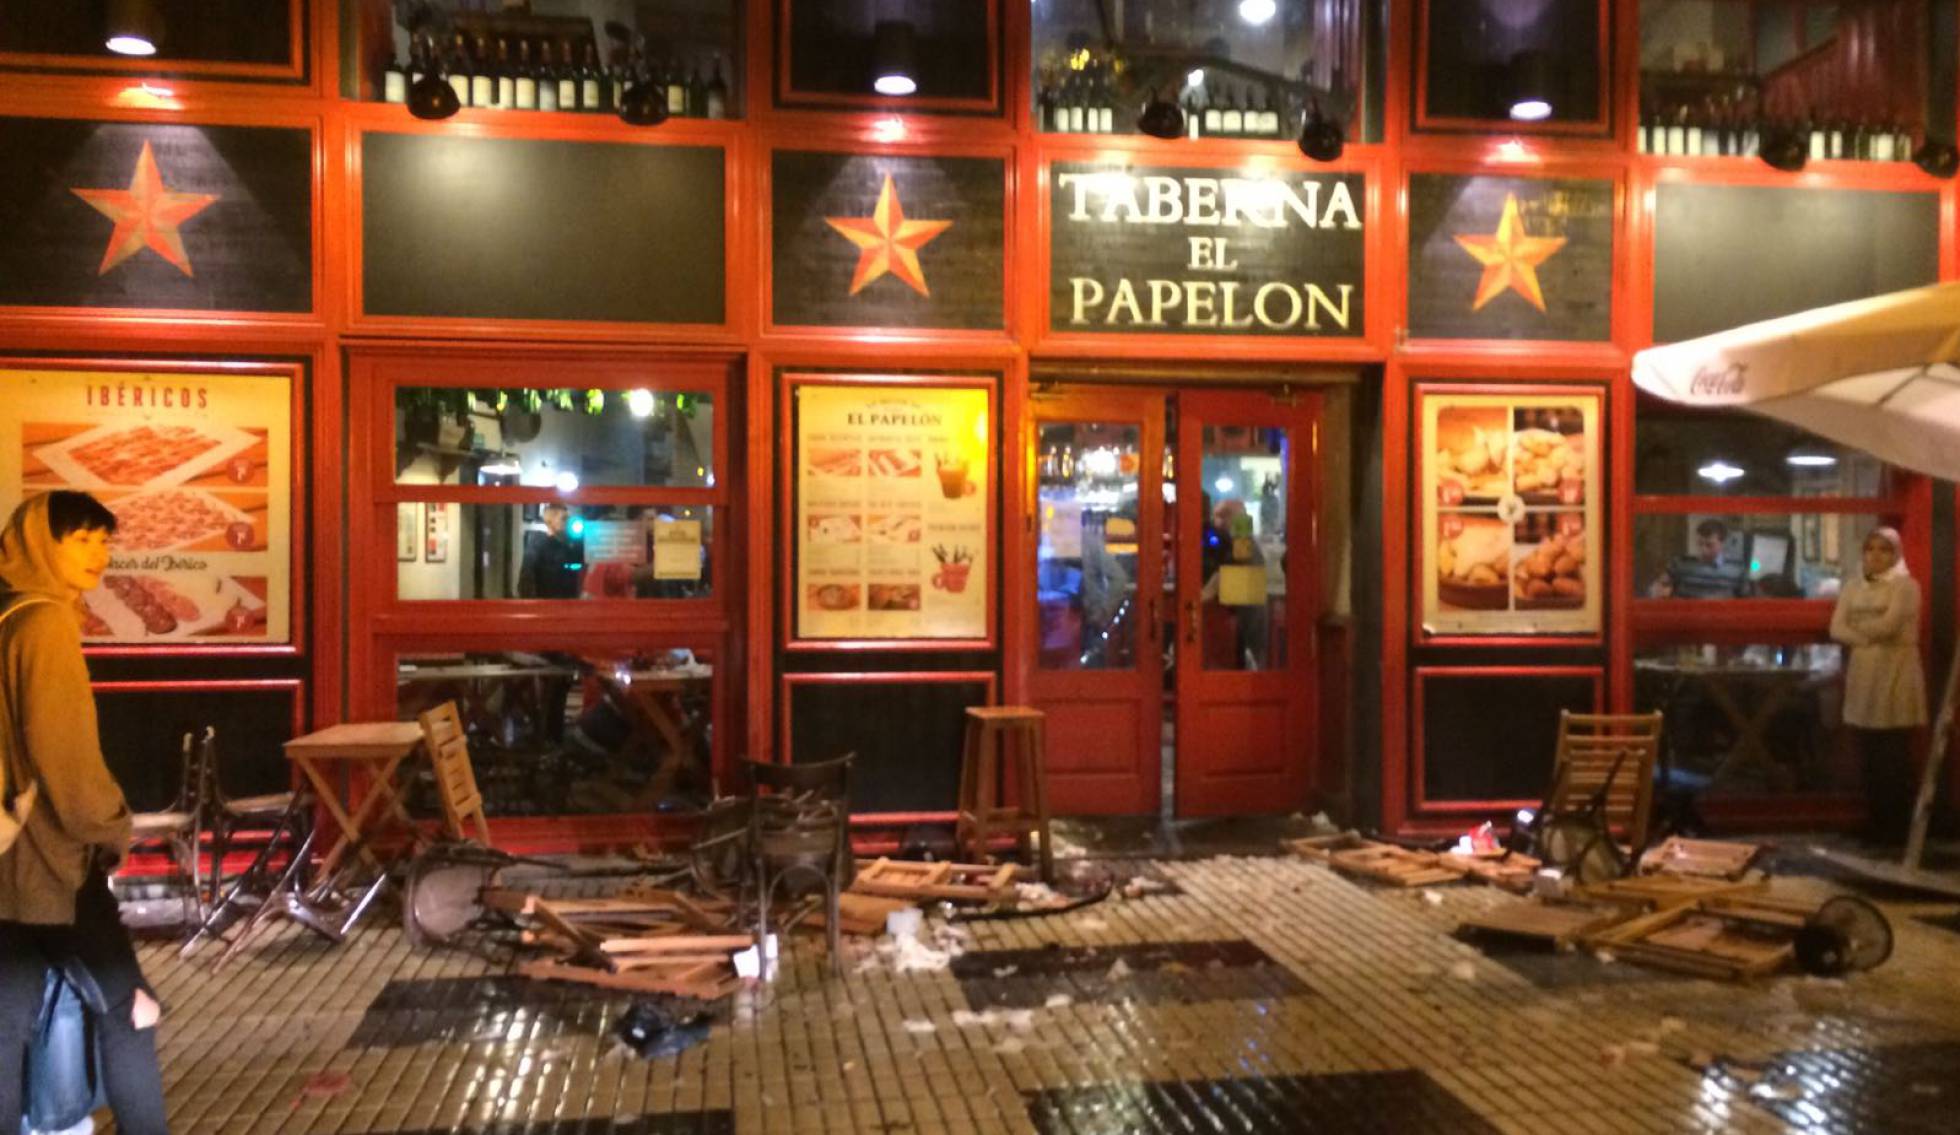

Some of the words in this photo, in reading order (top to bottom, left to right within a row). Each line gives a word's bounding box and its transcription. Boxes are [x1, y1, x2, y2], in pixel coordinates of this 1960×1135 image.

[1059, 174, 1363, 229] TABERNA
[1188, 237, 1238, 270] EL
[1069, 278, 1354, 329] PAPELON
[86, 383, 208, 408] IBÉRICOS
[847, 413, 864, 425] EL
